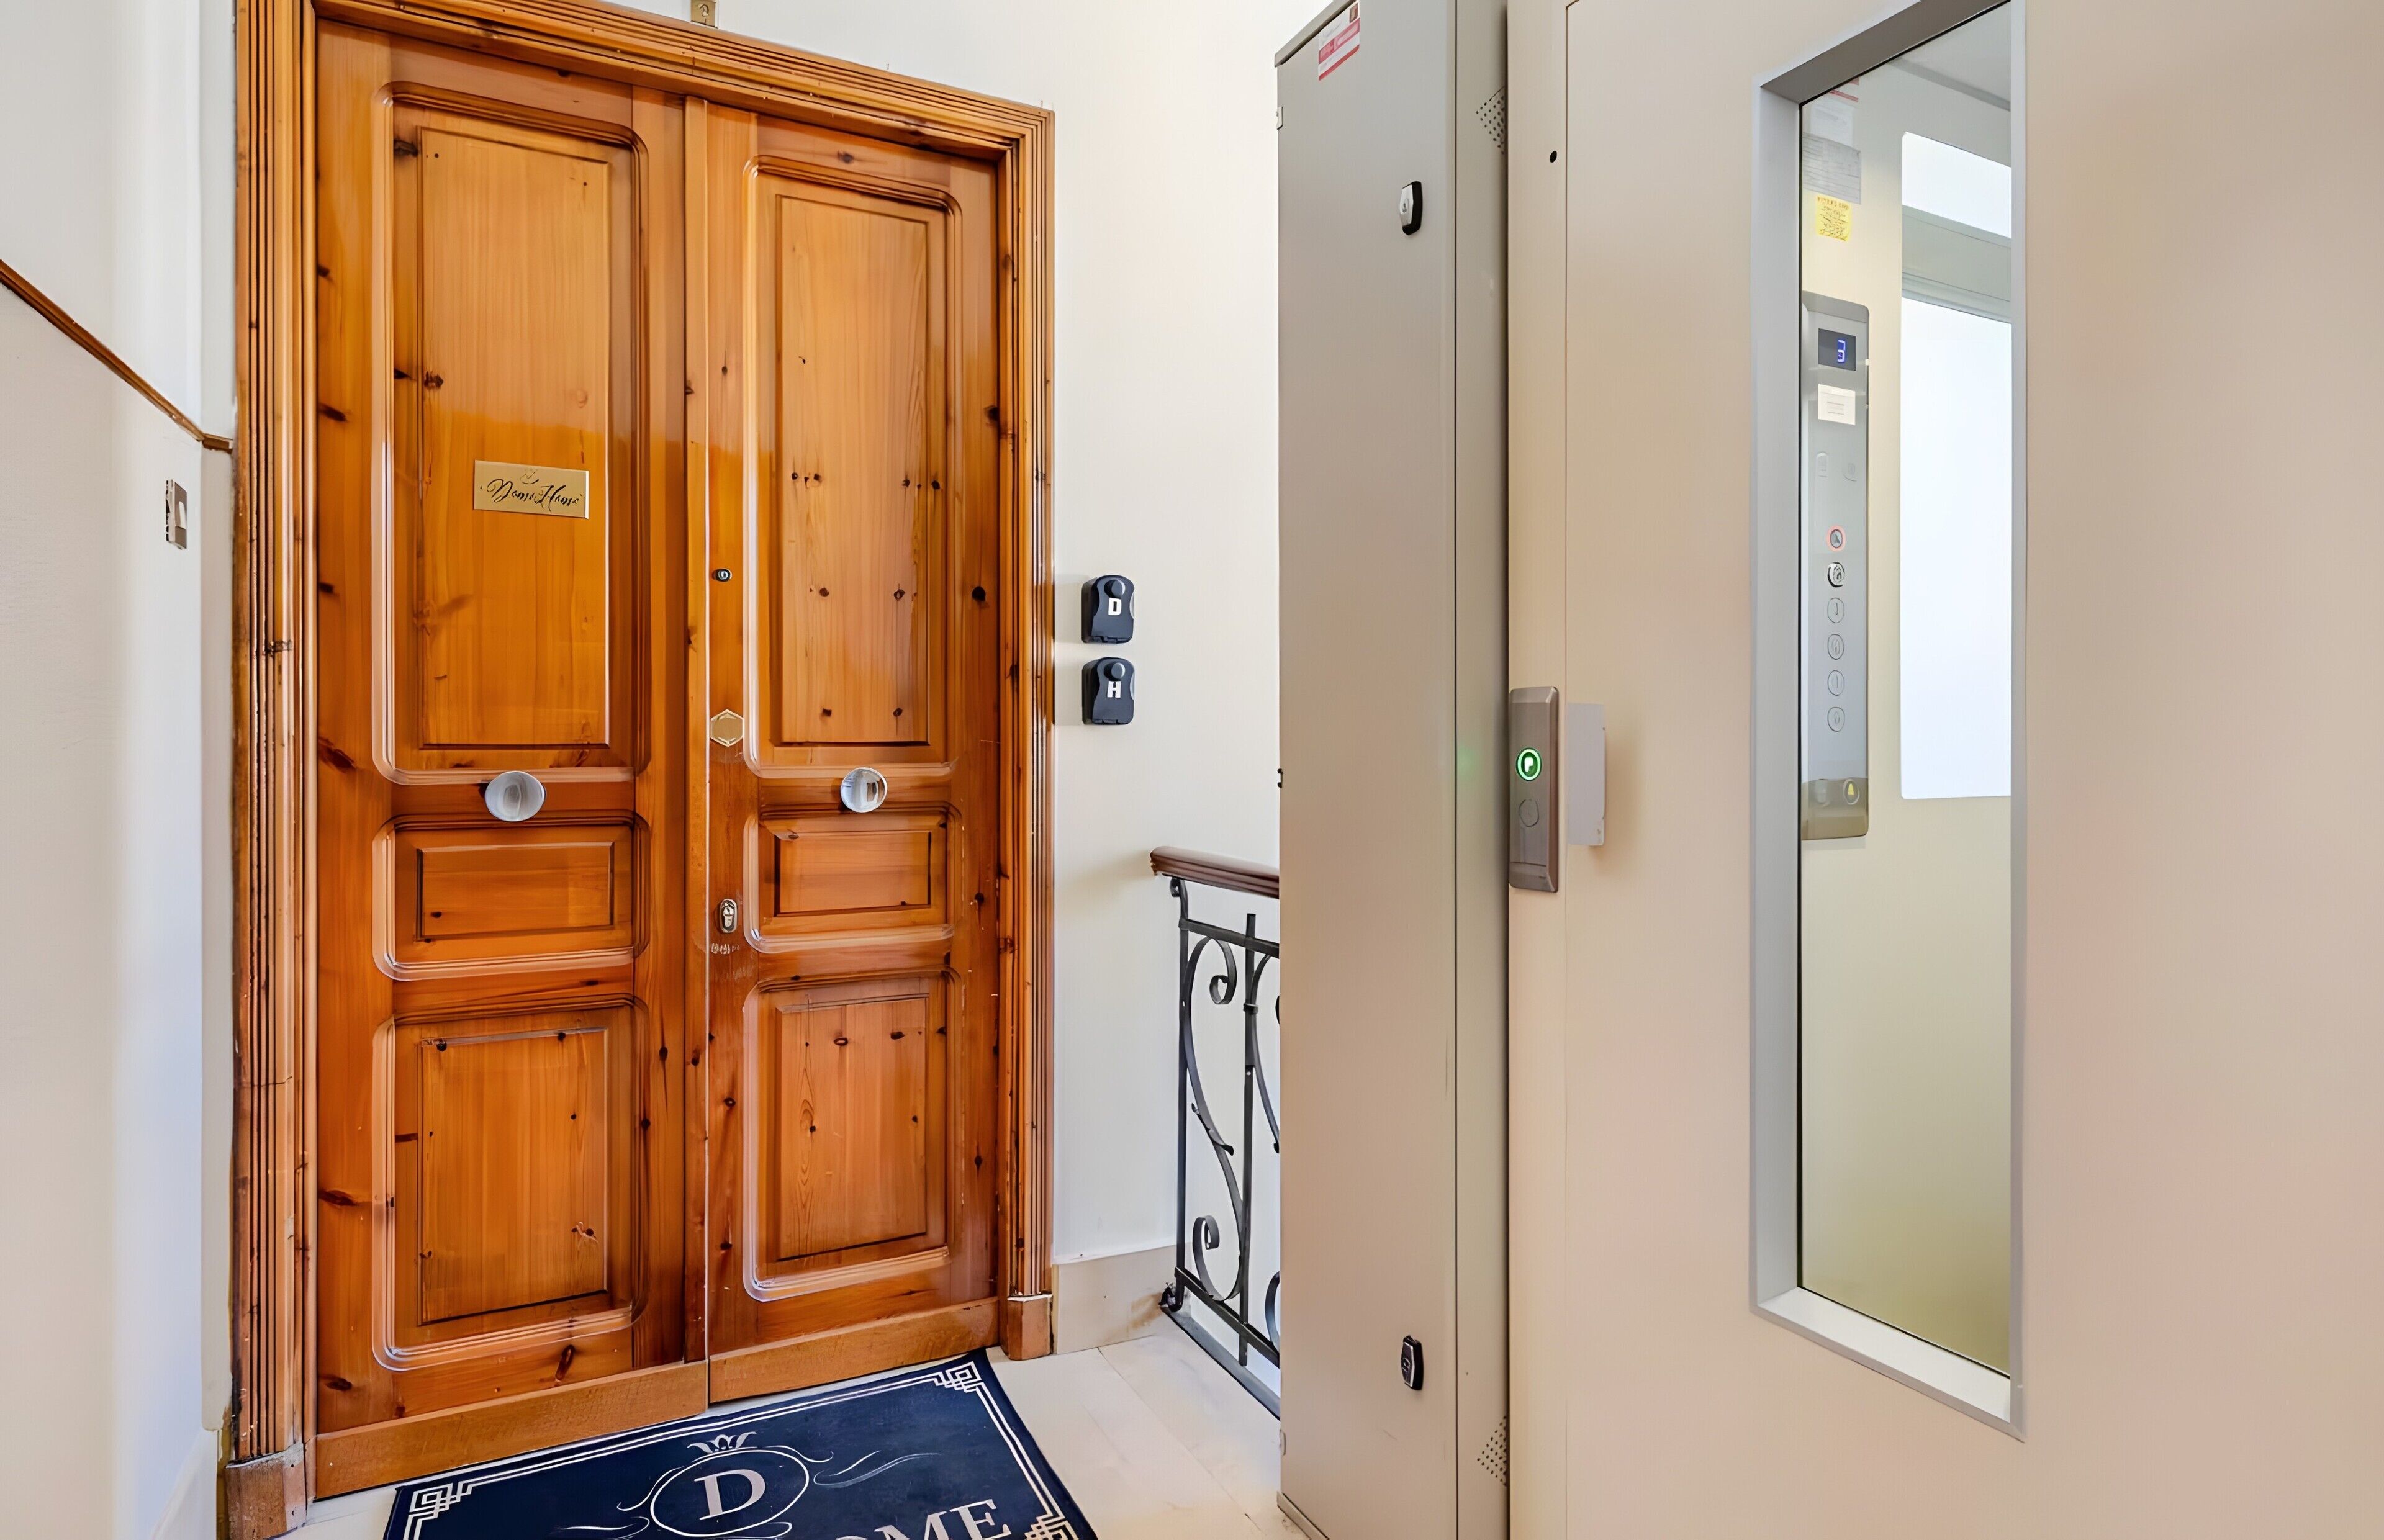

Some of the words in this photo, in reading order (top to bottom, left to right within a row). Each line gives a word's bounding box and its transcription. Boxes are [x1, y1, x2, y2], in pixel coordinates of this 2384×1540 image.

[1837, 340, 1846, 362] 3
[1108, 597, 1122, 616] D
[1106, 680, 1121, 698] H
[693, 1469, 766, 1520] D
